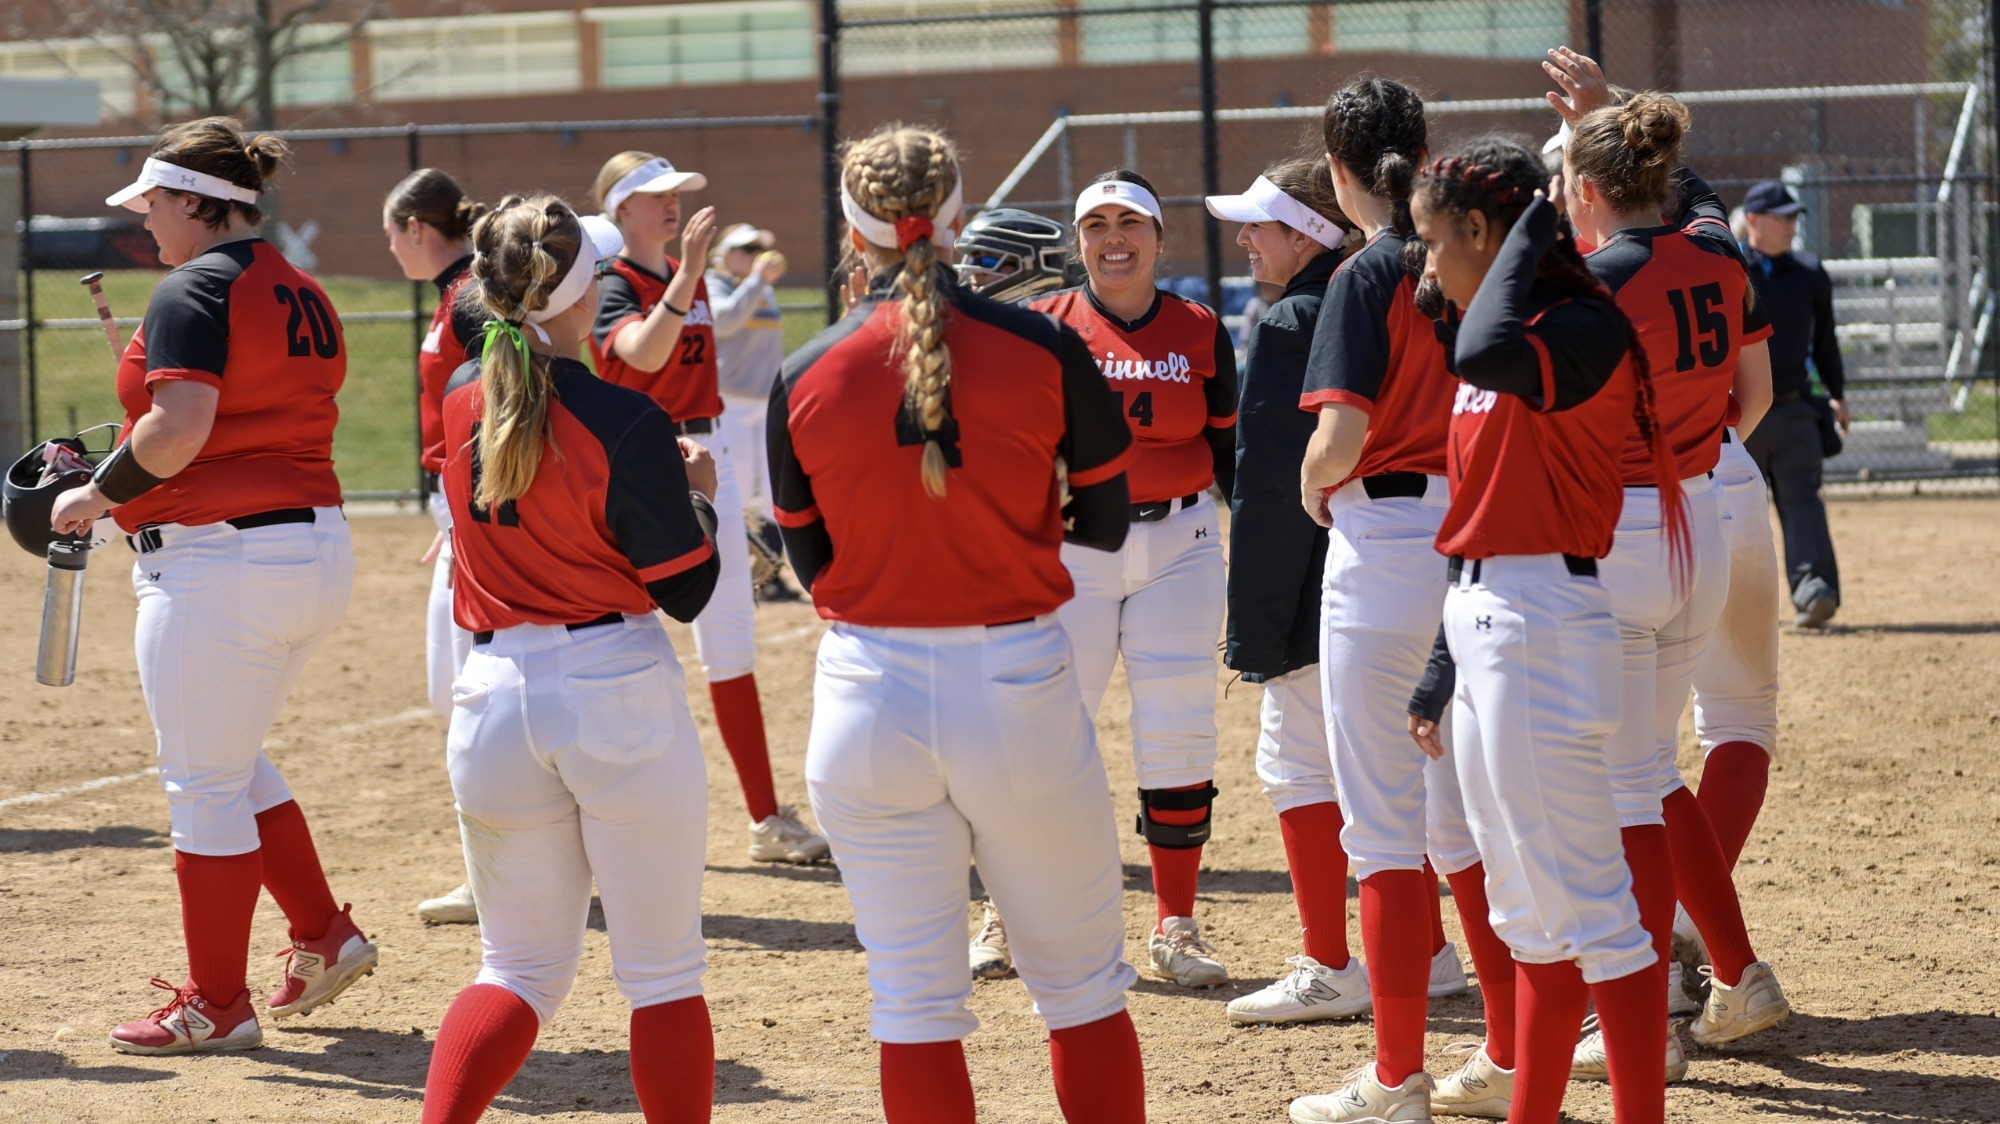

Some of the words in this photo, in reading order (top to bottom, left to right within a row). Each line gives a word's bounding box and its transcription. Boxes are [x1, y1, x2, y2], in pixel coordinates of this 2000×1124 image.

[273, 283, 339, 360] 20
[680, 333, 705, 367] 22
[1666, 281, 1729, 373] 15
